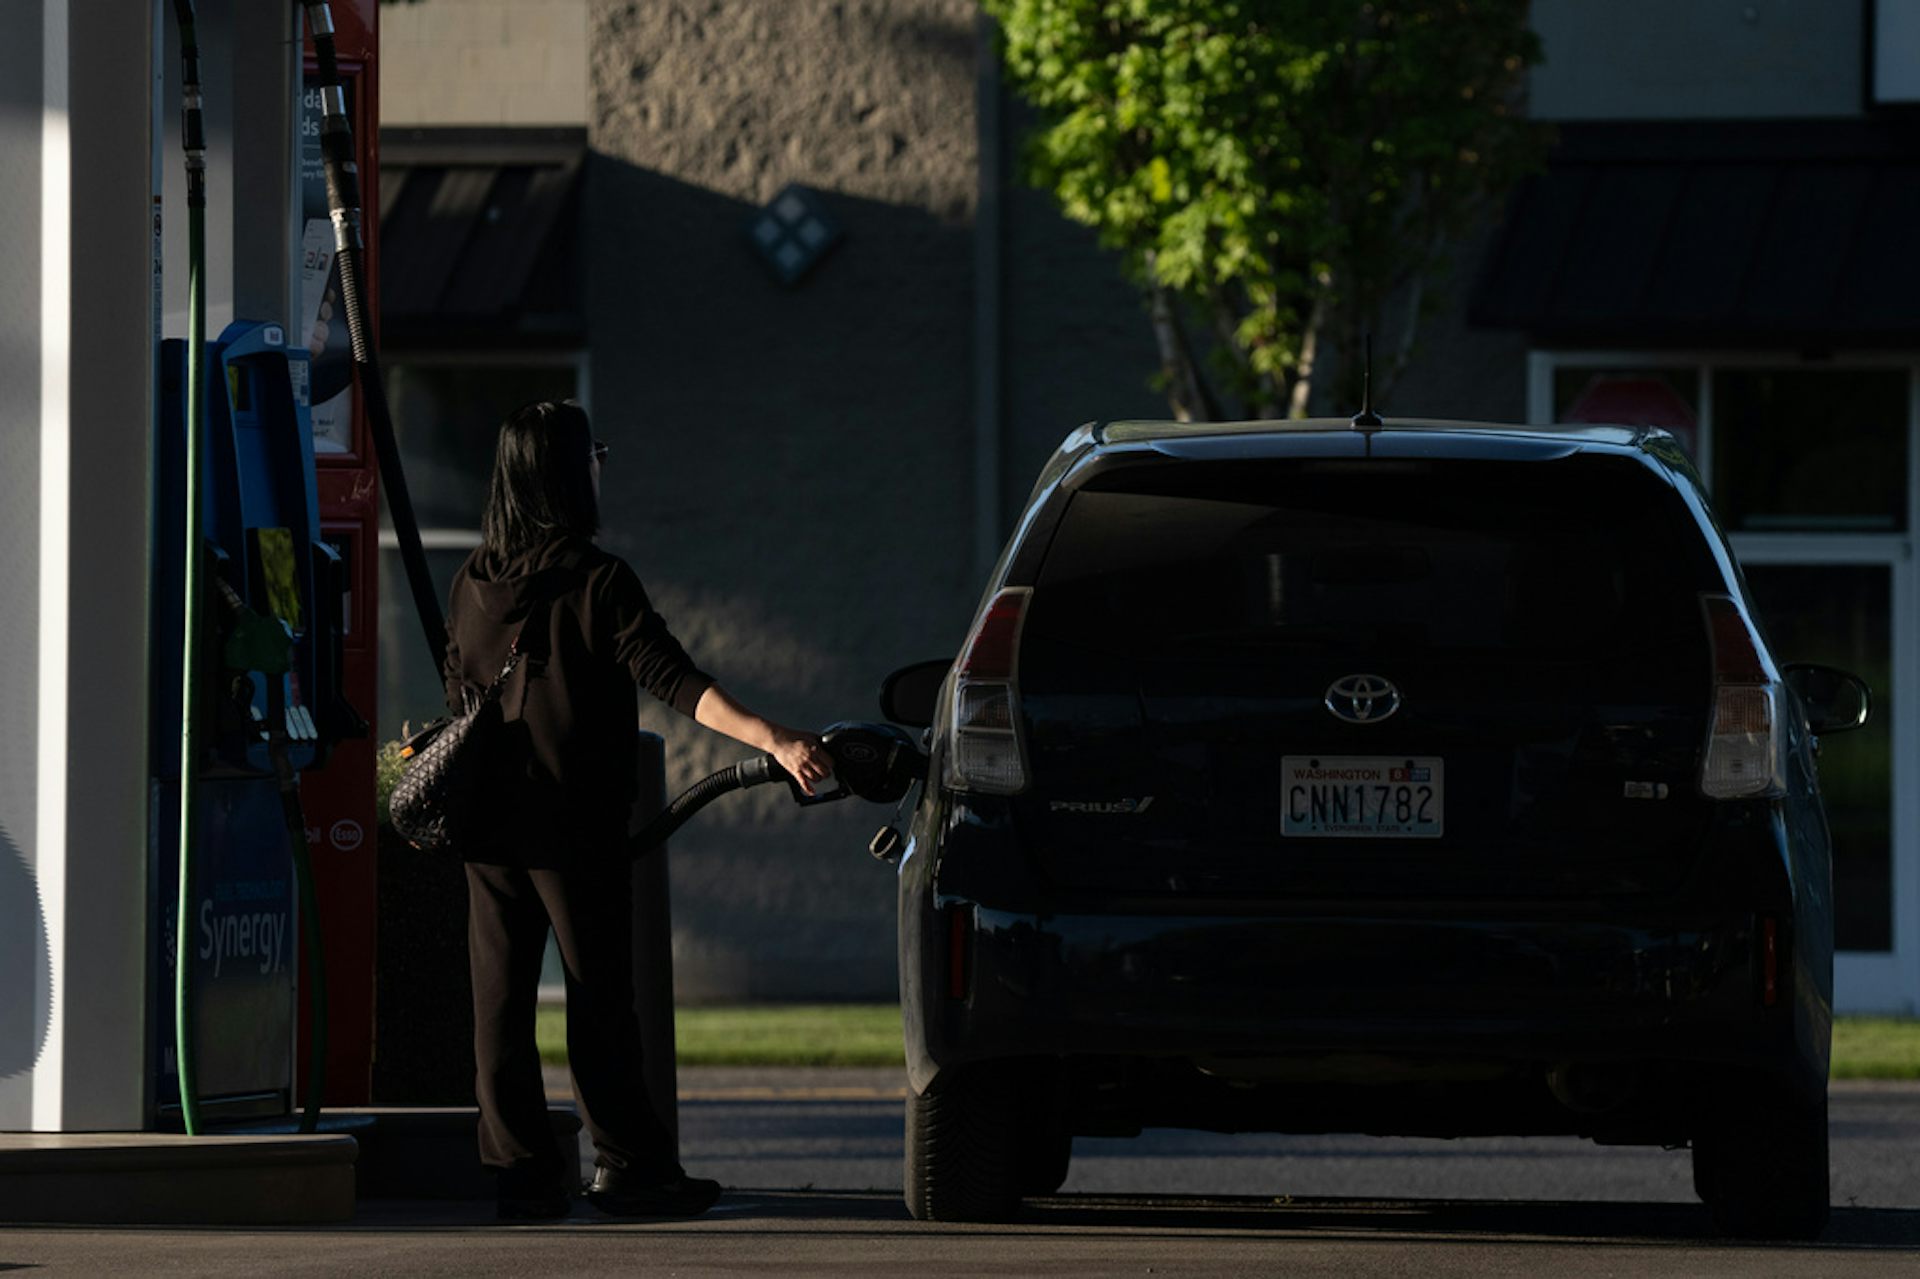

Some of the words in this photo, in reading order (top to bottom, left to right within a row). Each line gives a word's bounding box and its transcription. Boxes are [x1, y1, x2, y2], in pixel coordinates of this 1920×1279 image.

[1294, 769, 1381, 780] WASHINGTON
[1291, 785, 1433, 823] CNN1782
[200, 899, 286, 978] Synergy
